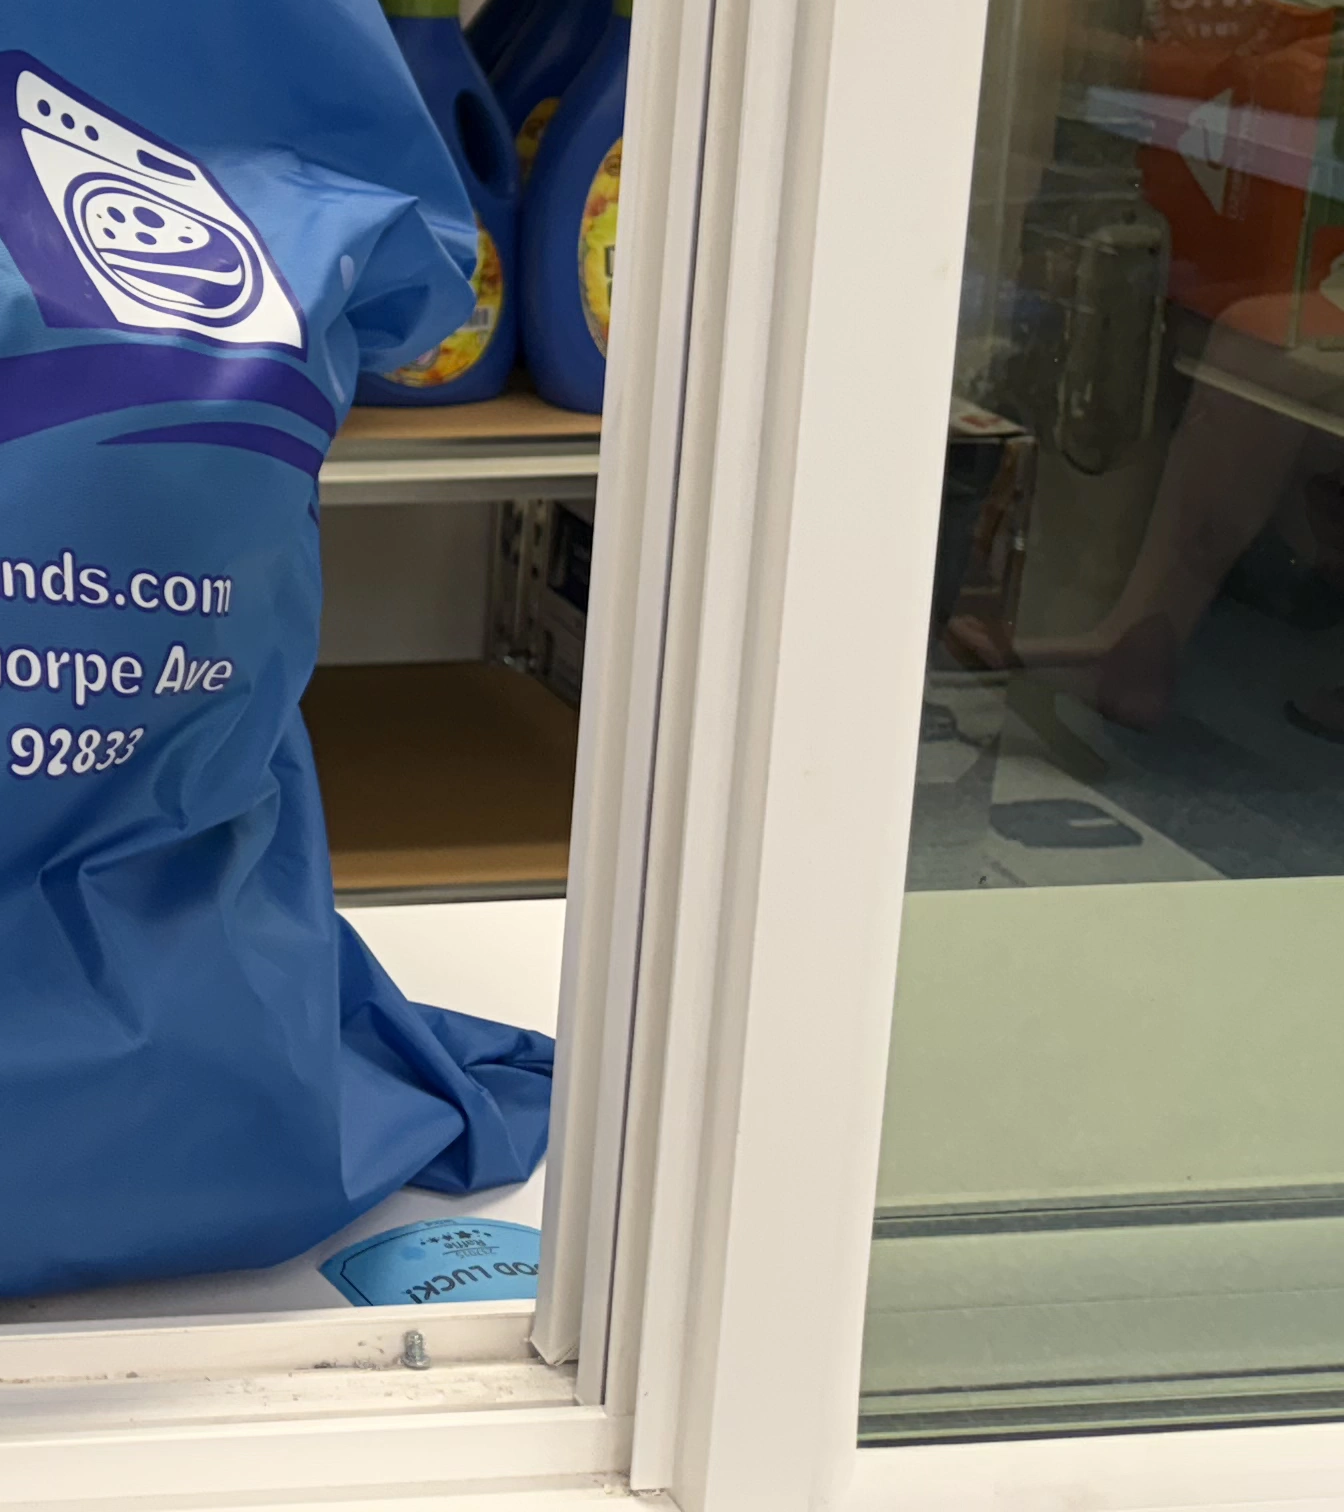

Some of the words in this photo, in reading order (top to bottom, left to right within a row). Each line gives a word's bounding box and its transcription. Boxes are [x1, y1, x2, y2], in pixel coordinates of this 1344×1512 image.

[154, 644, 233, 696] Ave
[10, 726, 145, 777] 92833
[405, 1265, 492, 1305] LUCK!
